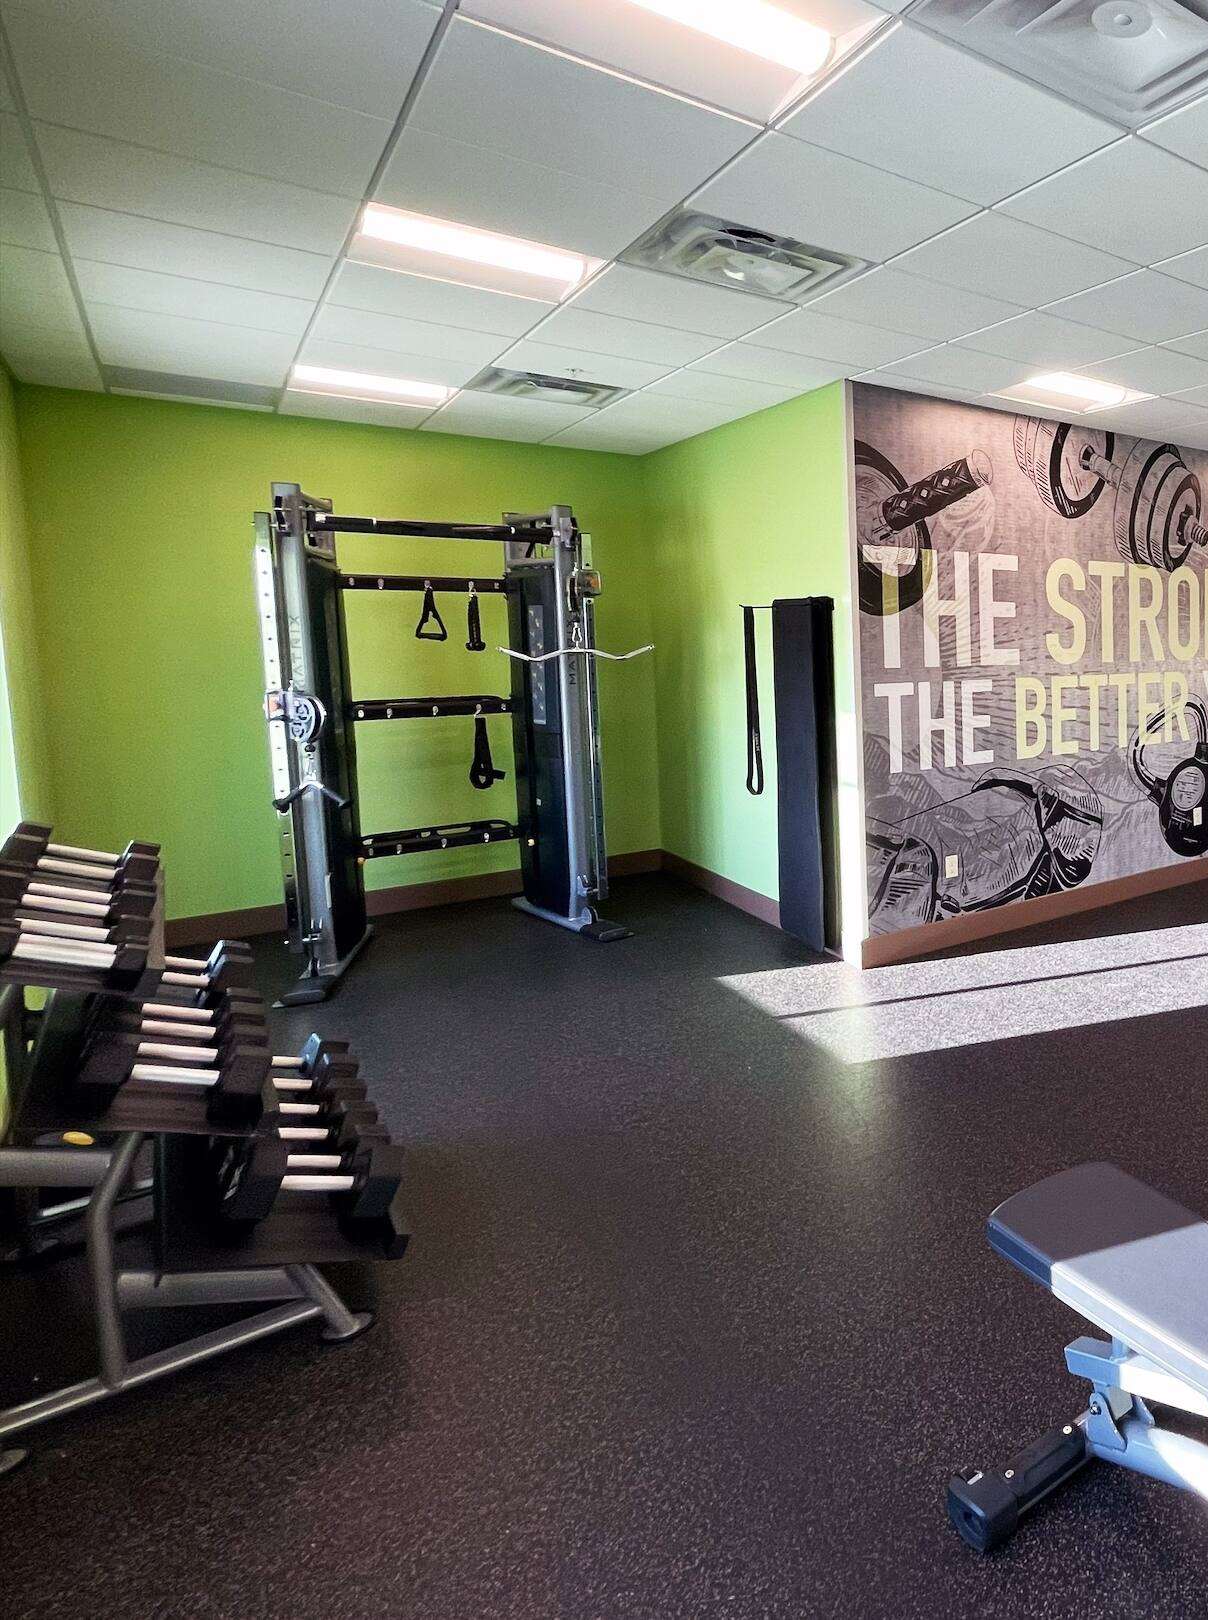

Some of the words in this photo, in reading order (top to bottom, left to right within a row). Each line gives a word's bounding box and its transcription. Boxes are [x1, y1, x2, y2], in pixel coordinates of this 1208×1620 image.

[862, 544, 1020, 669] THE
[874, 678, 994, 774] THE
[1015, 671, 1191, 760] BETTER
